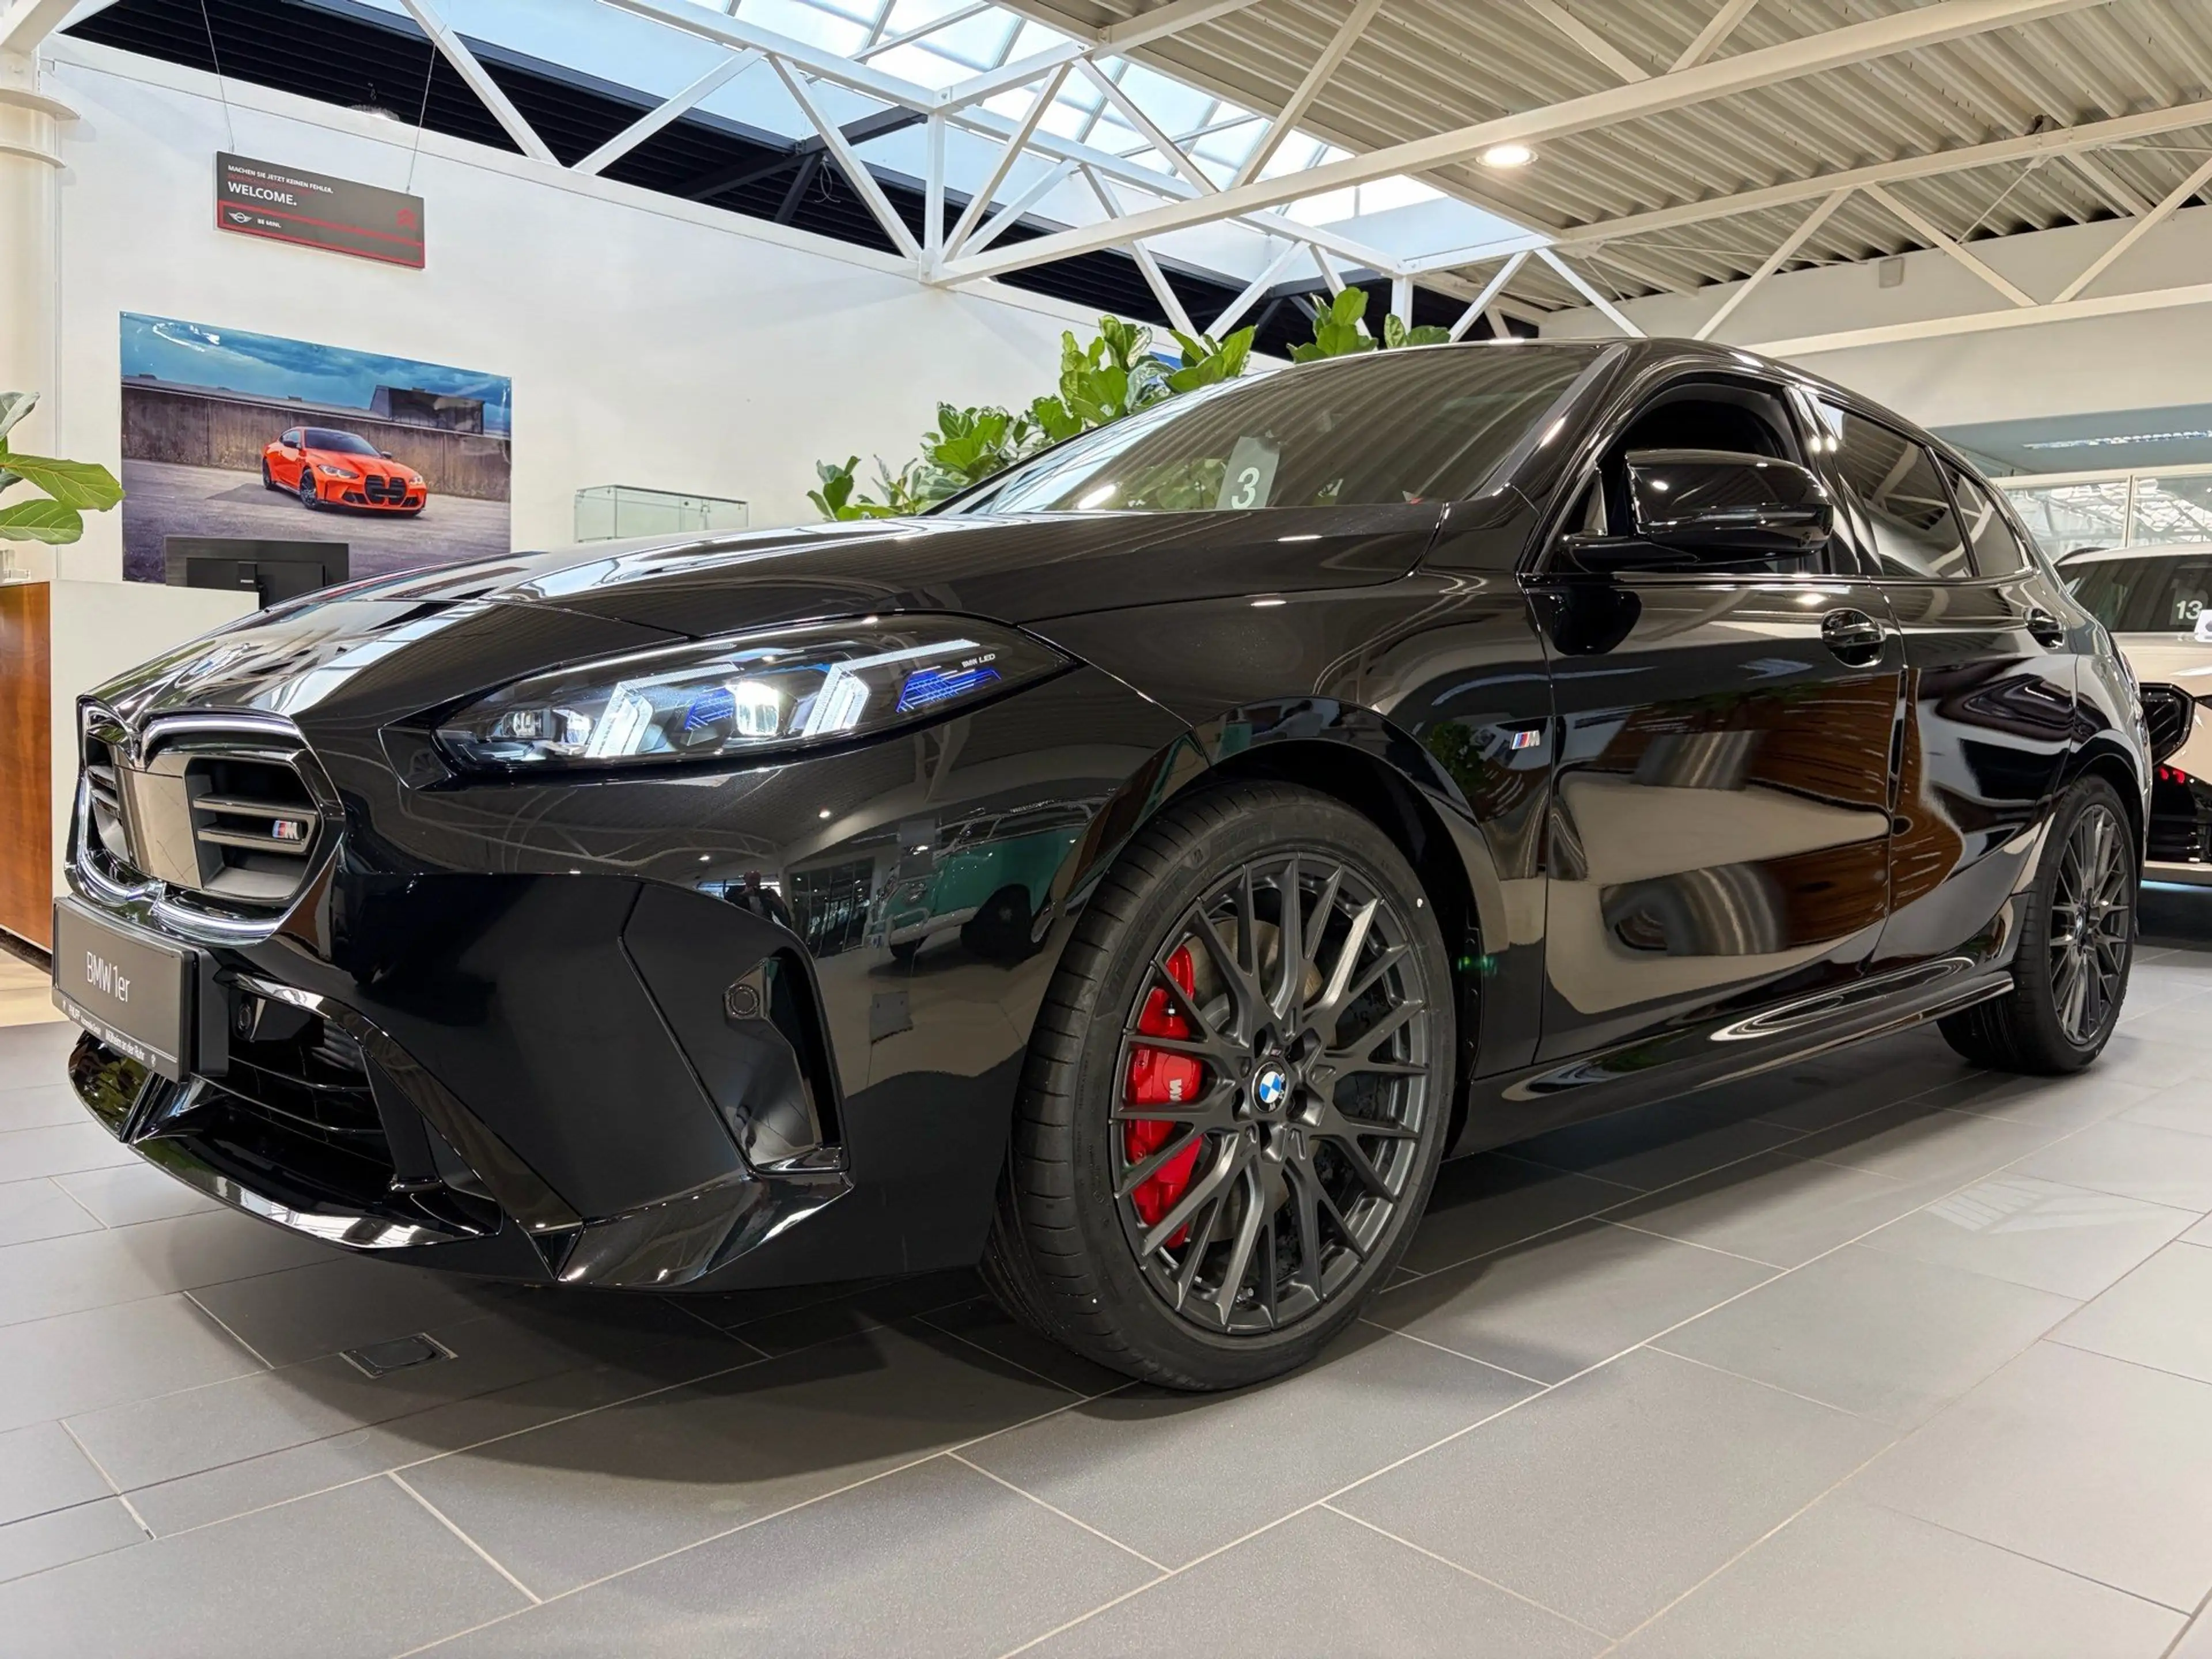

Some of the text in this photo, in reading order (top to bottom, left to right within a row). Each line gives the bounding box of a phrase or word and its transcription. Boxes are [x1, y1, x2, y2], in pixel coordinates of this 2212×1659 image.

[228, 165, 255, 176] MACHEN
[267, 174, 285, 183] JETZT
[285, 178, 309, 188] KEINEN
[228, 181, 297, 206] WELCOME.
[1231, 467, 1260, 509] 3
[2176, 600, 2203, 620] 13
[979, 653, 996, 664] LED
[281, 820, 299, 840] M
[86, 950, 131, 1003] BMW 1er
